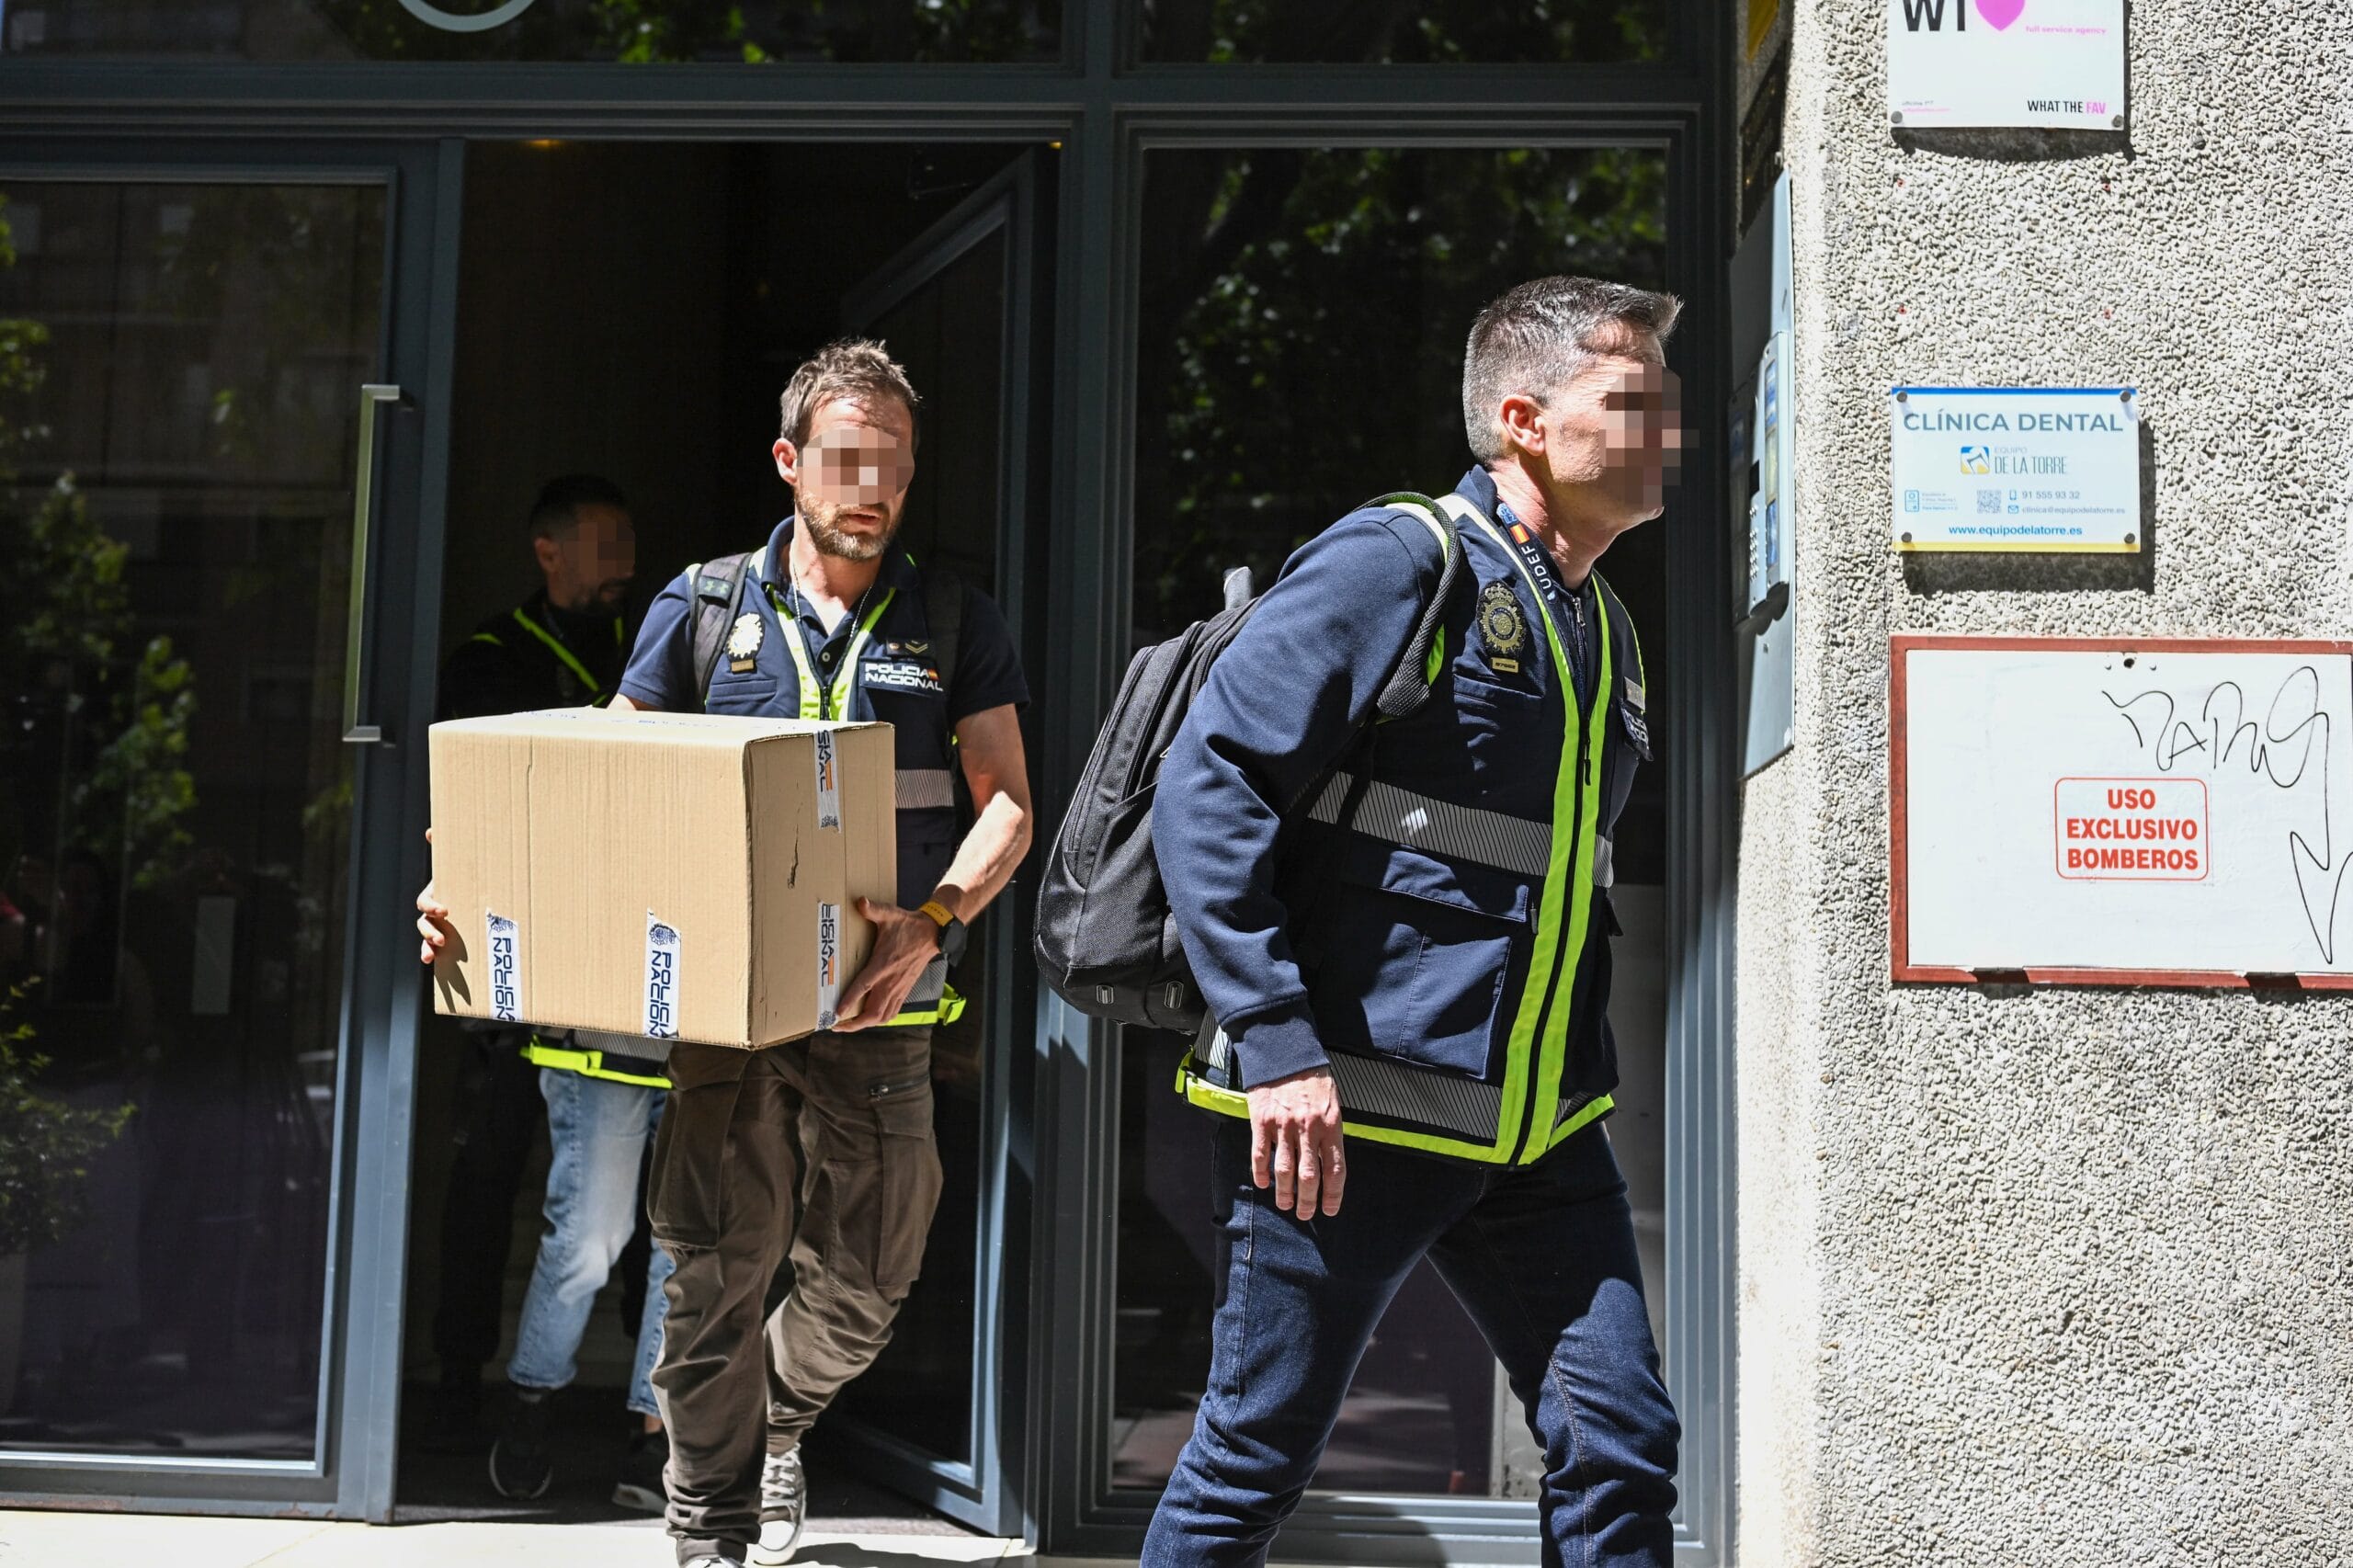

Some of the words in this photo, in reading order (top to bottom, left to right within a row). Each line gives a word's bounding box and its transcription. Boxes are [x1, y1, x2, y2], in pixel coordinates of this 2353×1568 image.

[2027, 99, 2060, 112] WHAT
[2063, 100, 2084, 113] THE
[2086, 102, 2107, 114] FAV
[1904, 408, 2010, 431] CLÍNICA
[2018, 413, 2123, 431] DENTAL
[1995, 456, 2007, 474] DE
[2013, 456, 2029, 474] LA
[2031, 456, 2067, 474] TORRE
[1949, 525, 2083, 537] www.equipodelatorre.es
[1520, 545, 1552, 589] UDEF
[865, 663, 929, 678] POLICIA
[864, 672, 944, 692] NACIONAL
[2108, 788, 2156, 810] USO
[2066, 818, 2198, 840] EXCLUSIVO
[2067, 847, 2199, 870] BOMBEROS
